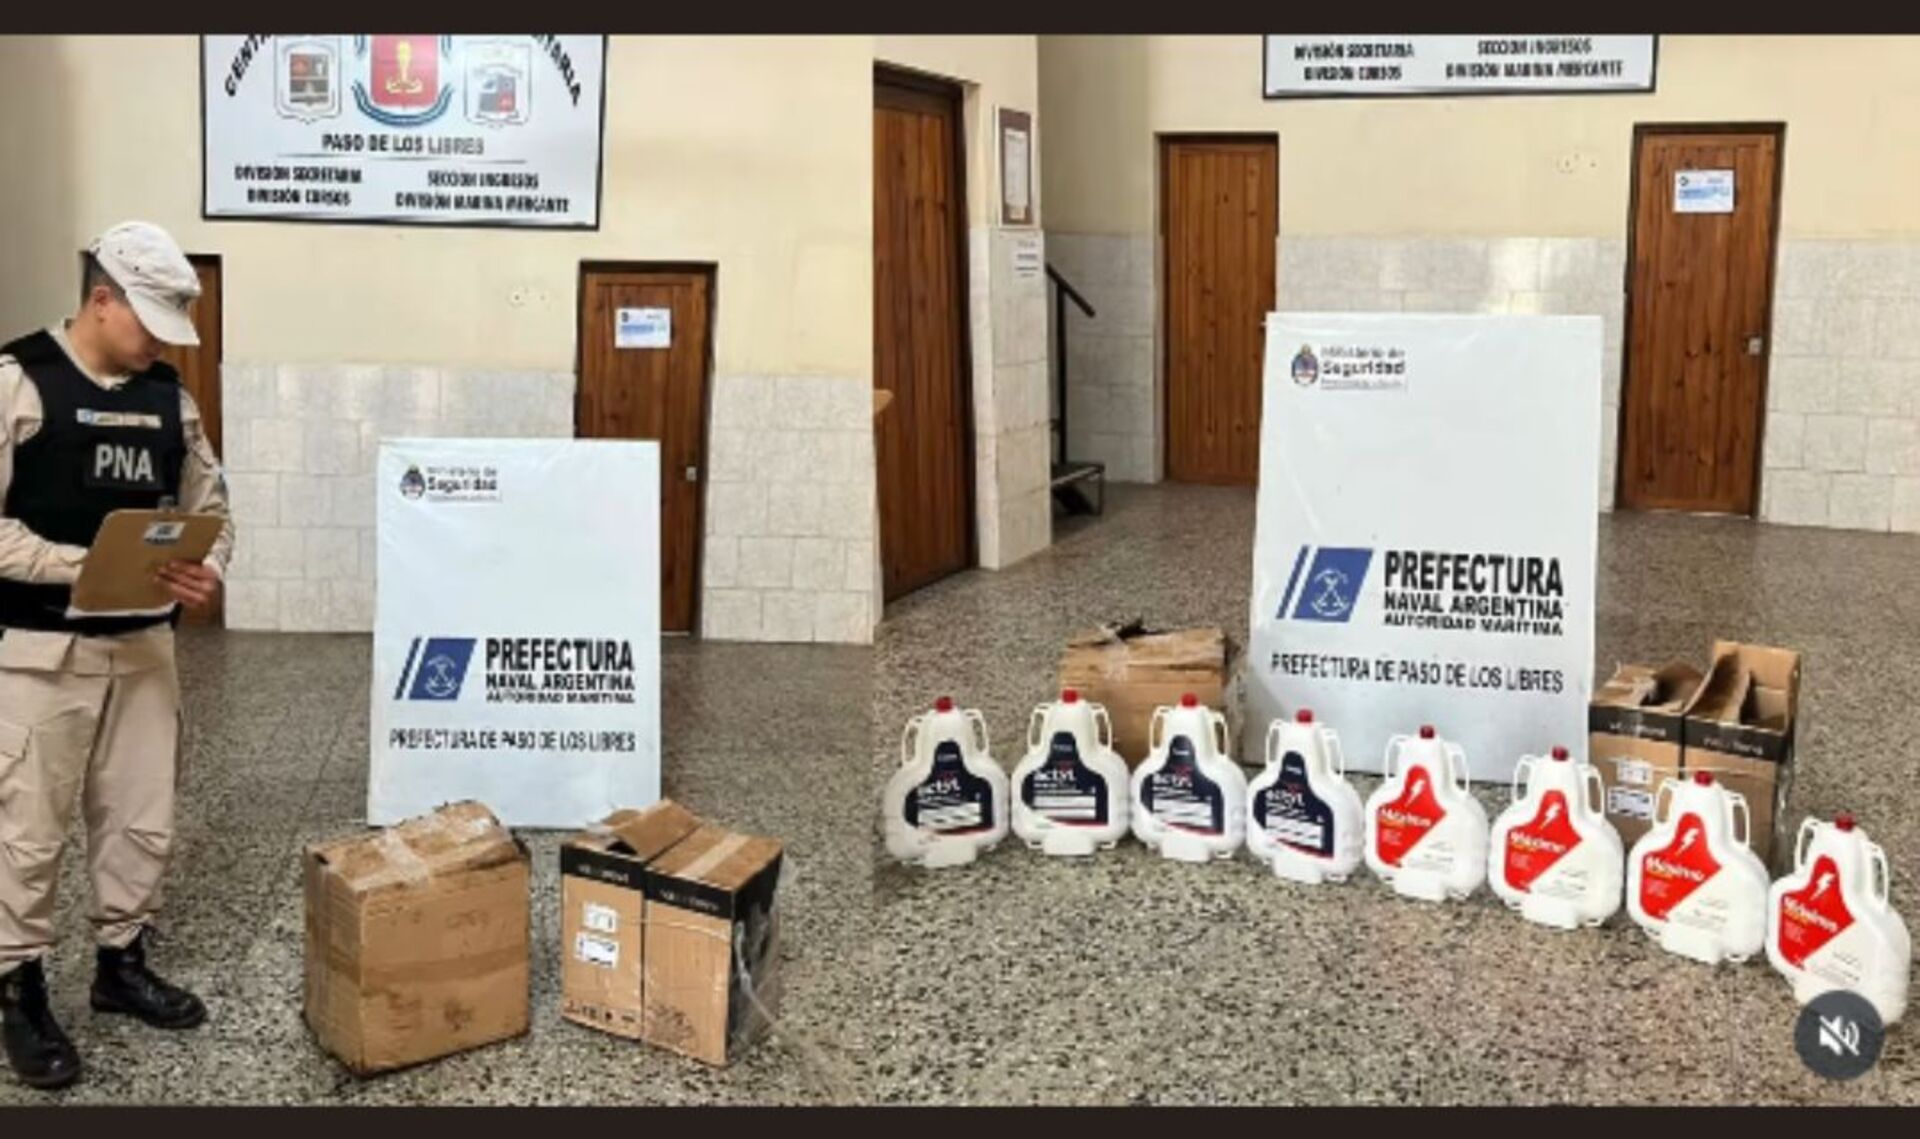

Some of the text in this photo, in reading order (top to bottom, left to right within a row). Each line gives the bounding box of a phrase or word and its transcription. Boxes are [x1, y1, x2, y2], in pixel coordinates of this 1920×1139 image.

[322, 134, 485, 155] PASO DE LOS LIBRES
[506, 196, 570, 213] MERCANTE
[1323, 361, 1405, 378] Seguridad
[94, 443, 155, 482] PNA
[428, 476, 497, 494] Seguridad
[1384, 550, 1563, 597] PREFECTURA
[1384, 590, 1563, 620] NAVAL ARGENTINA
[1383, 613, 1476, 630] AUTORIDAD
[486, 637, 635, 672] PREFECTURA
[486, 673, 635, 690] NAVAL ARGENTINA
[1271, 652, 1564, 695] PREFECTURA DE PASO DE LOS LIBRES
[486, 691, 564, 704] AUTORIDAD
[389, 728, 637, 752] PREFECTURA DE PASO DE LOS LIBRES
